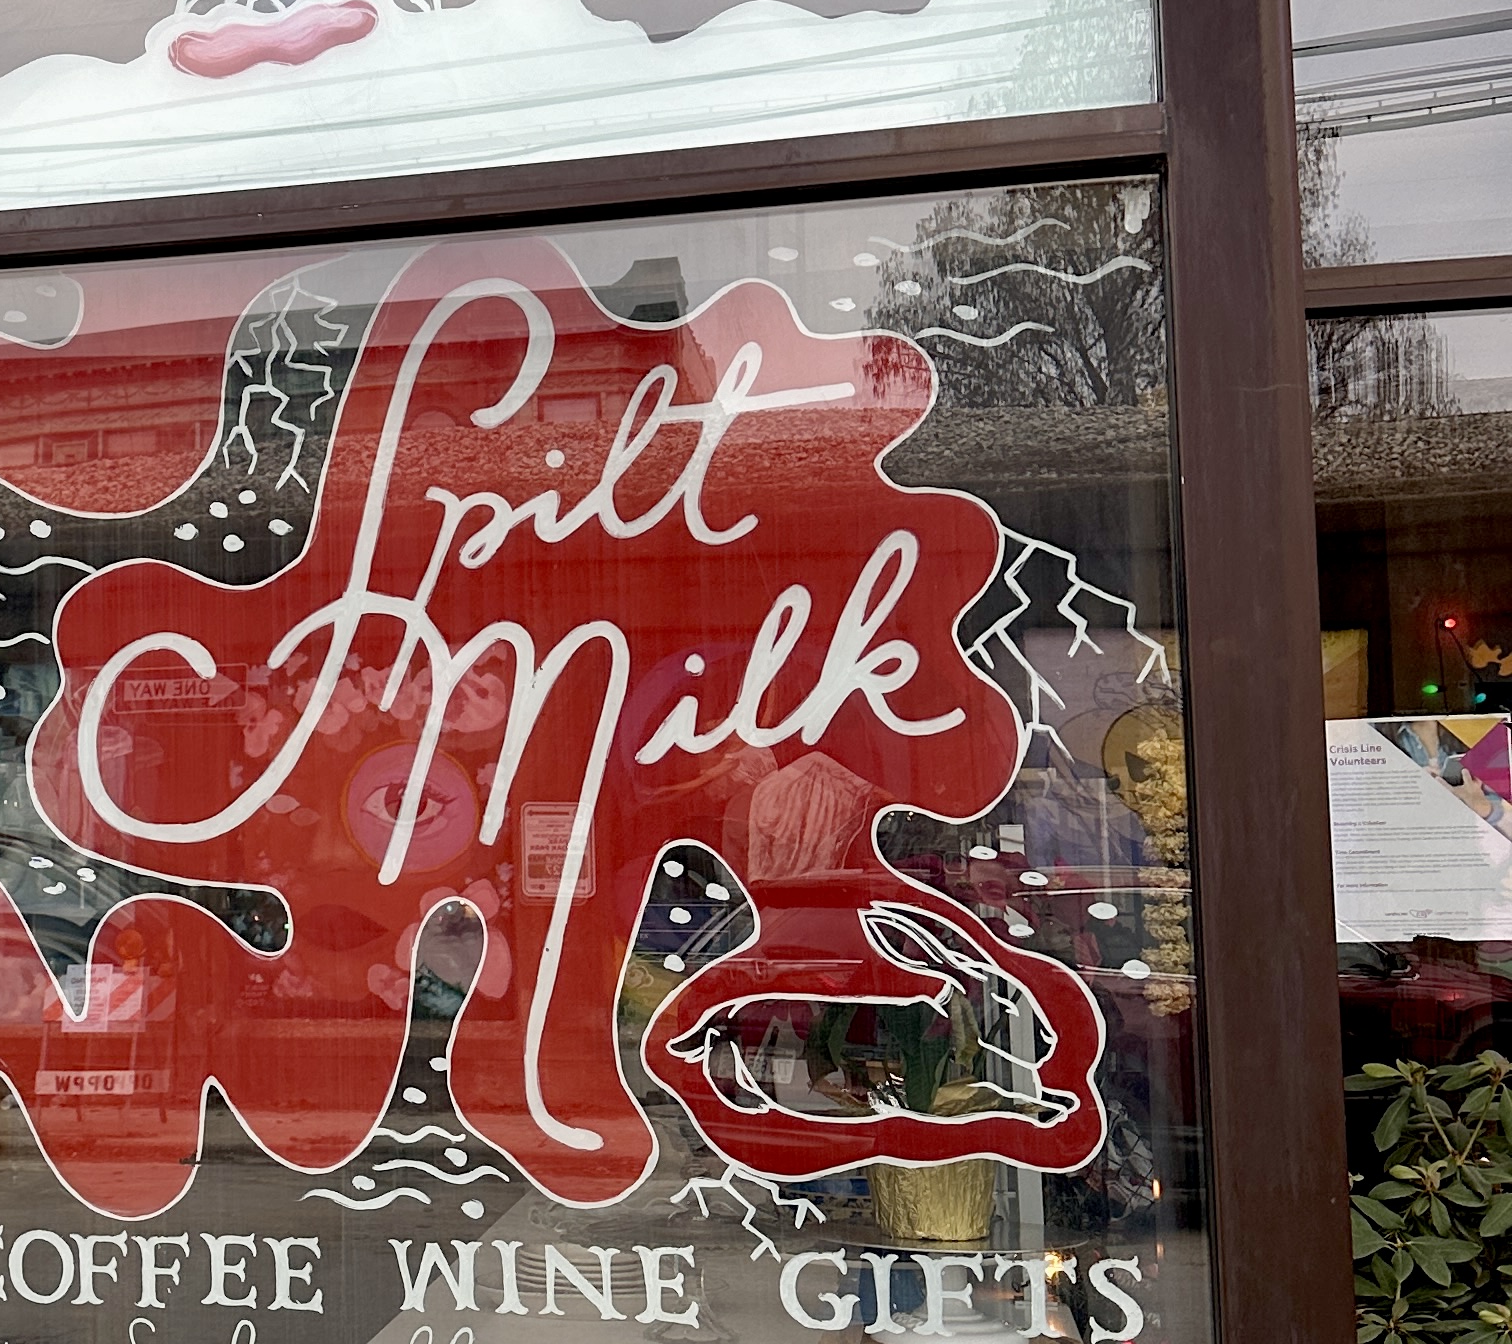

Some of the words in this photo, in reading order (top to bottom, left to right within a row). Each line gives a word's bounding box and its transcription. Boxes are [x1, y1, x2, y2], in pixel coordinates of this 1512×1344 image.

[78, 278, 855, 843] Spilt
[1329, 744, 1358, 754] Crisis
[1360, 743, 1382, 753] Line
[1329, 756, 1387, 766] Volunteers
[268, 530, 965, 1150] Milk
[387, 1239, 701, 1329] WINE
